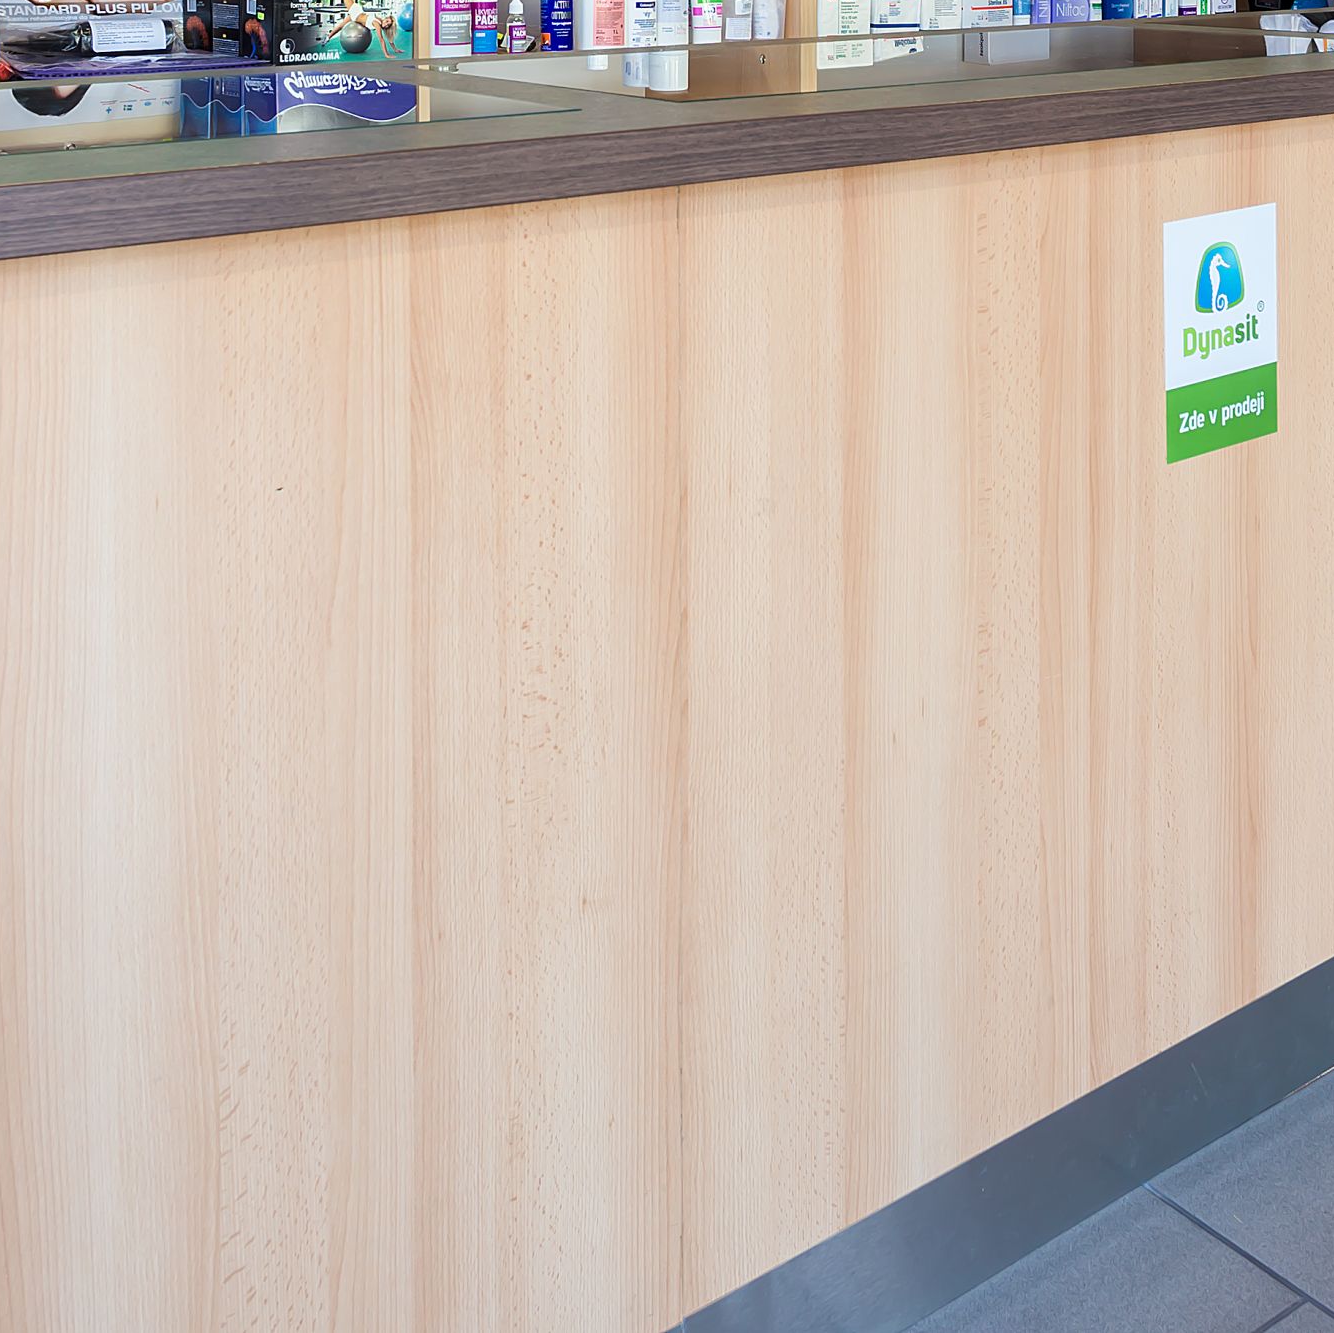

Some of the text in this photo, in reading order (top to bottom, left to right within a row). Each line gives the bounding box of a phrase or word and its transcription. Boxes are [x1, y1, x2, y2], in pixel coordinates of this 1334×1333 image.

[85, 3, 127, 14] PLUS
[131, 3, 184, 14] PILLOW
[1056, 2, 1085, 18] Niltac
[280, 53, 340, 63] LEDRAGOMMA
[1183, 313, 1259, 360] Dynasit
[1179, 391, 1265, 434] Zde v prodeji
